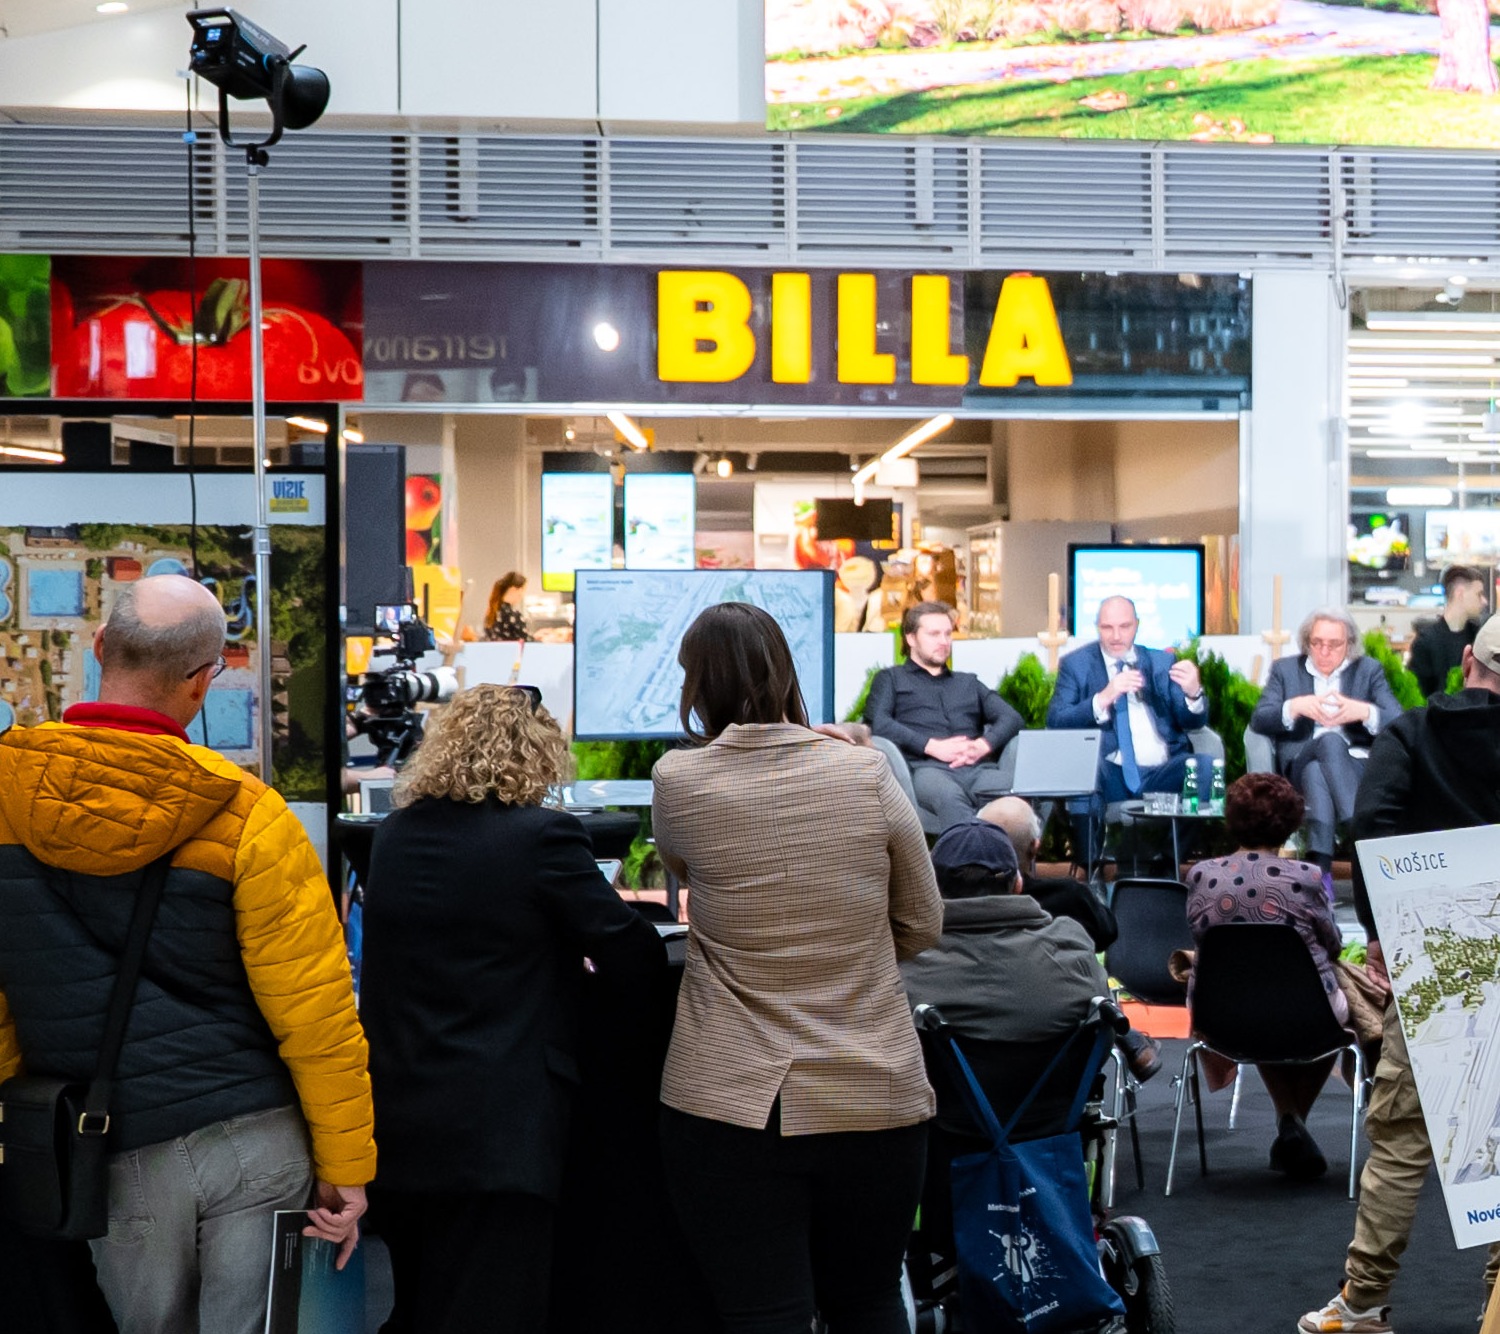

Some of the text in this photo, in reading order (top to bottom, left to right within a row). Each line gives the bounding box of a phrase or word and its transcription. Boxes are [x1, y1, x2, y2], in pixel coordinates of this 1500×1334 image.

[658, 270, 1073, 387] BILLA
[272, 478, 306, 500] VÍZIE
[1396, 851, 1449, 875] KOŠICE
